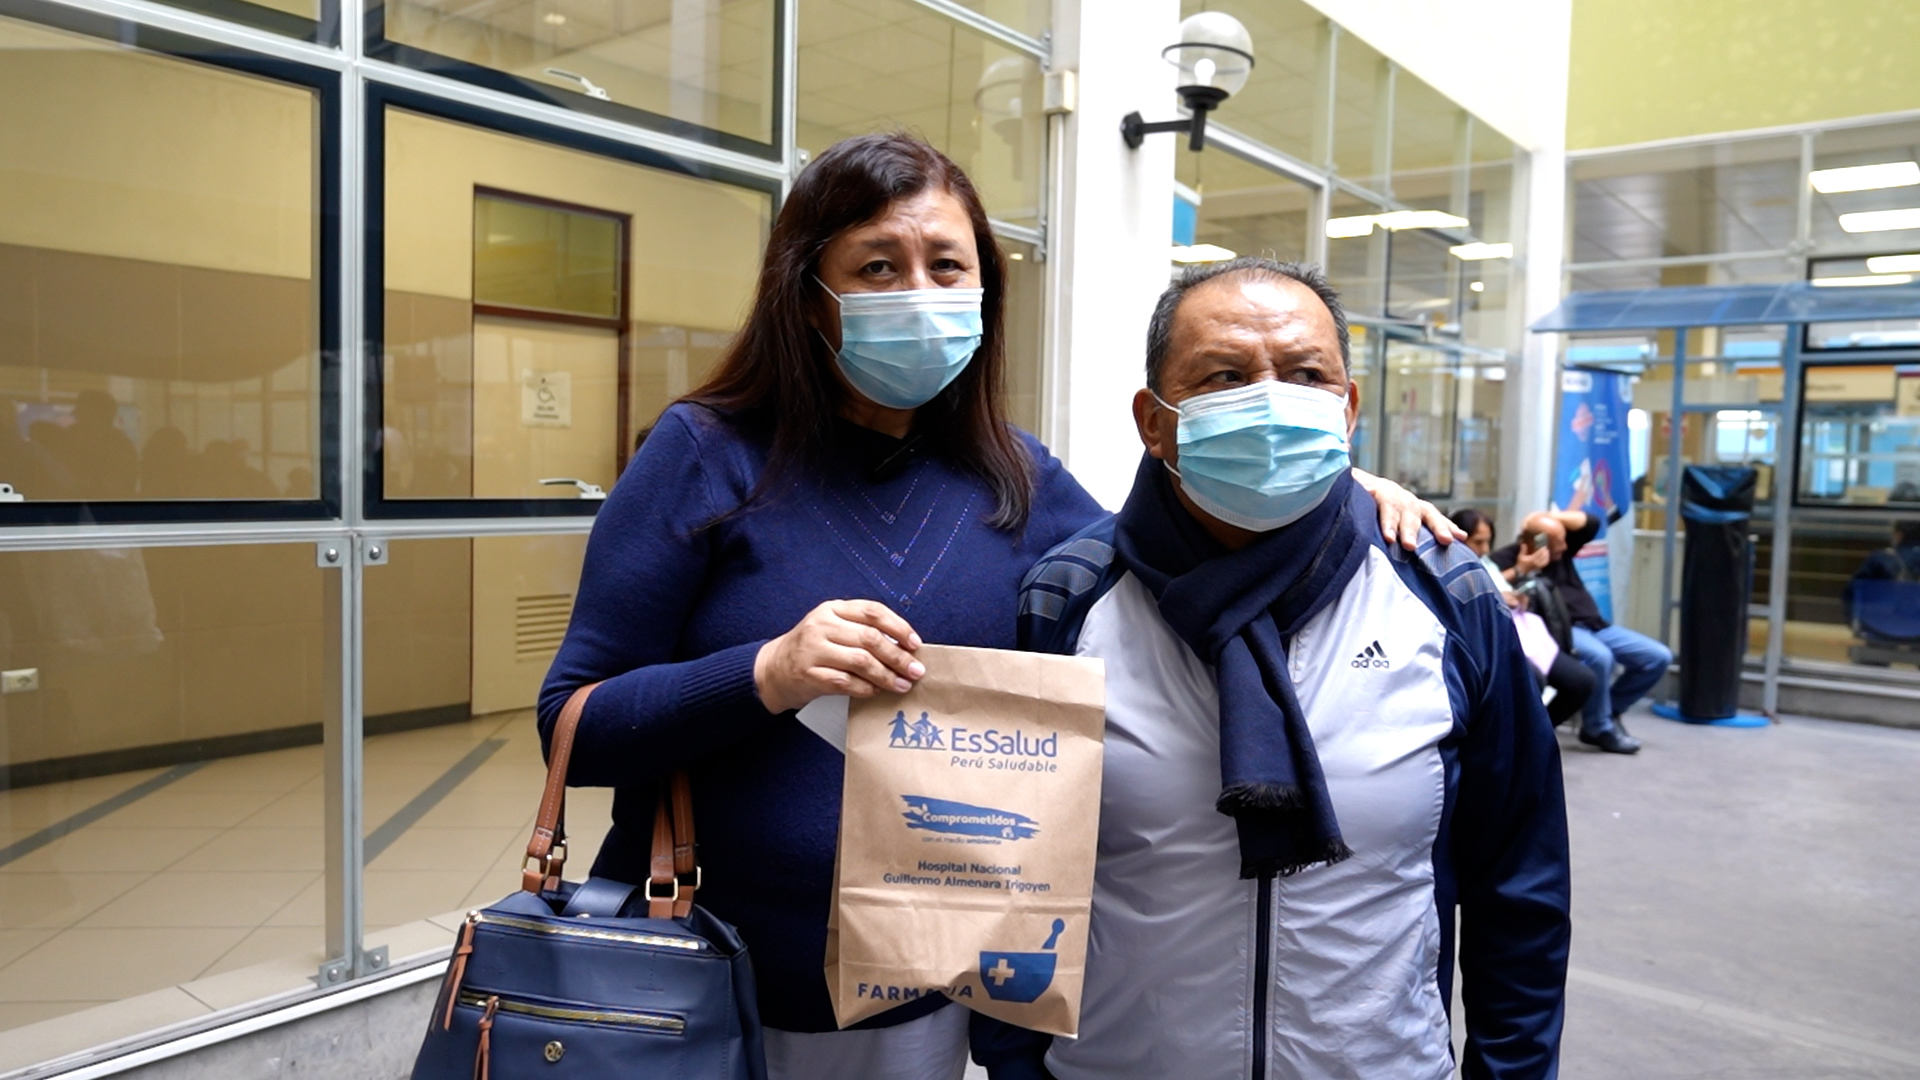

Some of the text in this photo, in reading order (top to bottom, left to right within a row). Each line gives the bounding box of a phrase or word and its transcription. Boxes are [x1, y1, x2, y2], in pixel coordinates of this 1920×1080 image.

[951, 727, 1058, 758] EsSalud
[950, 756, 1058, 773] Perú Saludable
[922, 812, 1016, 826] Comprometidos
[917, 860, 1022, 876] Hospital Nacional
[883, 873, 1051, 893] Guillermo Almenara Irigoyen
[858, 982, 973, 1000] FARMIA
